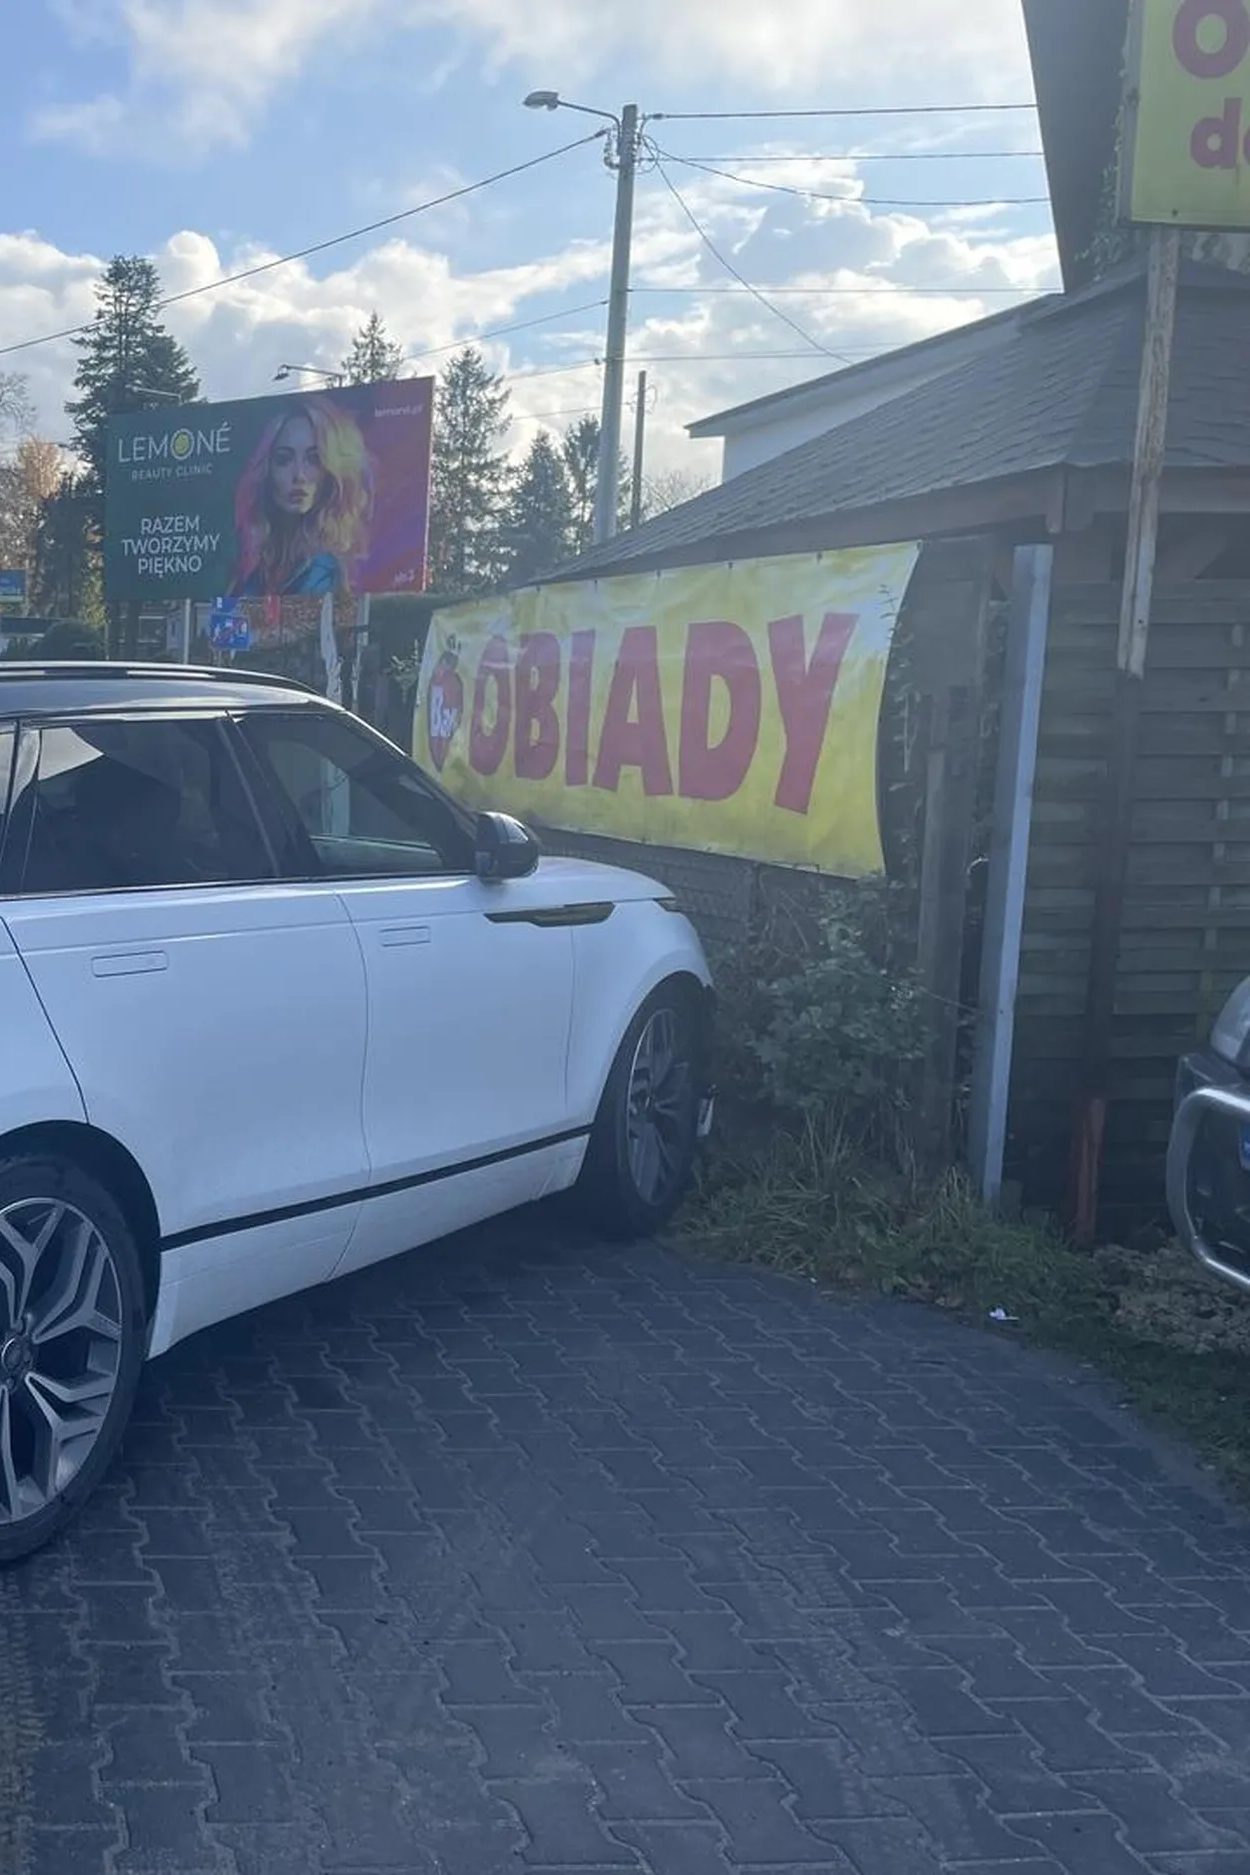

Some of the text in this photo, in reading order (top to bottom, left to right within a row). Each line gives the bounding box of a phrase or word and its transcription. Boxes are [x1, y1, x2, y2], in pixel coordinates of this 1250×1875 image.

[118, 421, 231, 463] LEMONÉ
[131, 462, 214, 480] BEAUTY CLINIC
[141, 514, 200, 535] RAZEM
[121, 533, 220, 556] TWORZYMY
[138, 555, 202, 578] PIĘKNO
[468, 612, 860, 815] OBIADY
